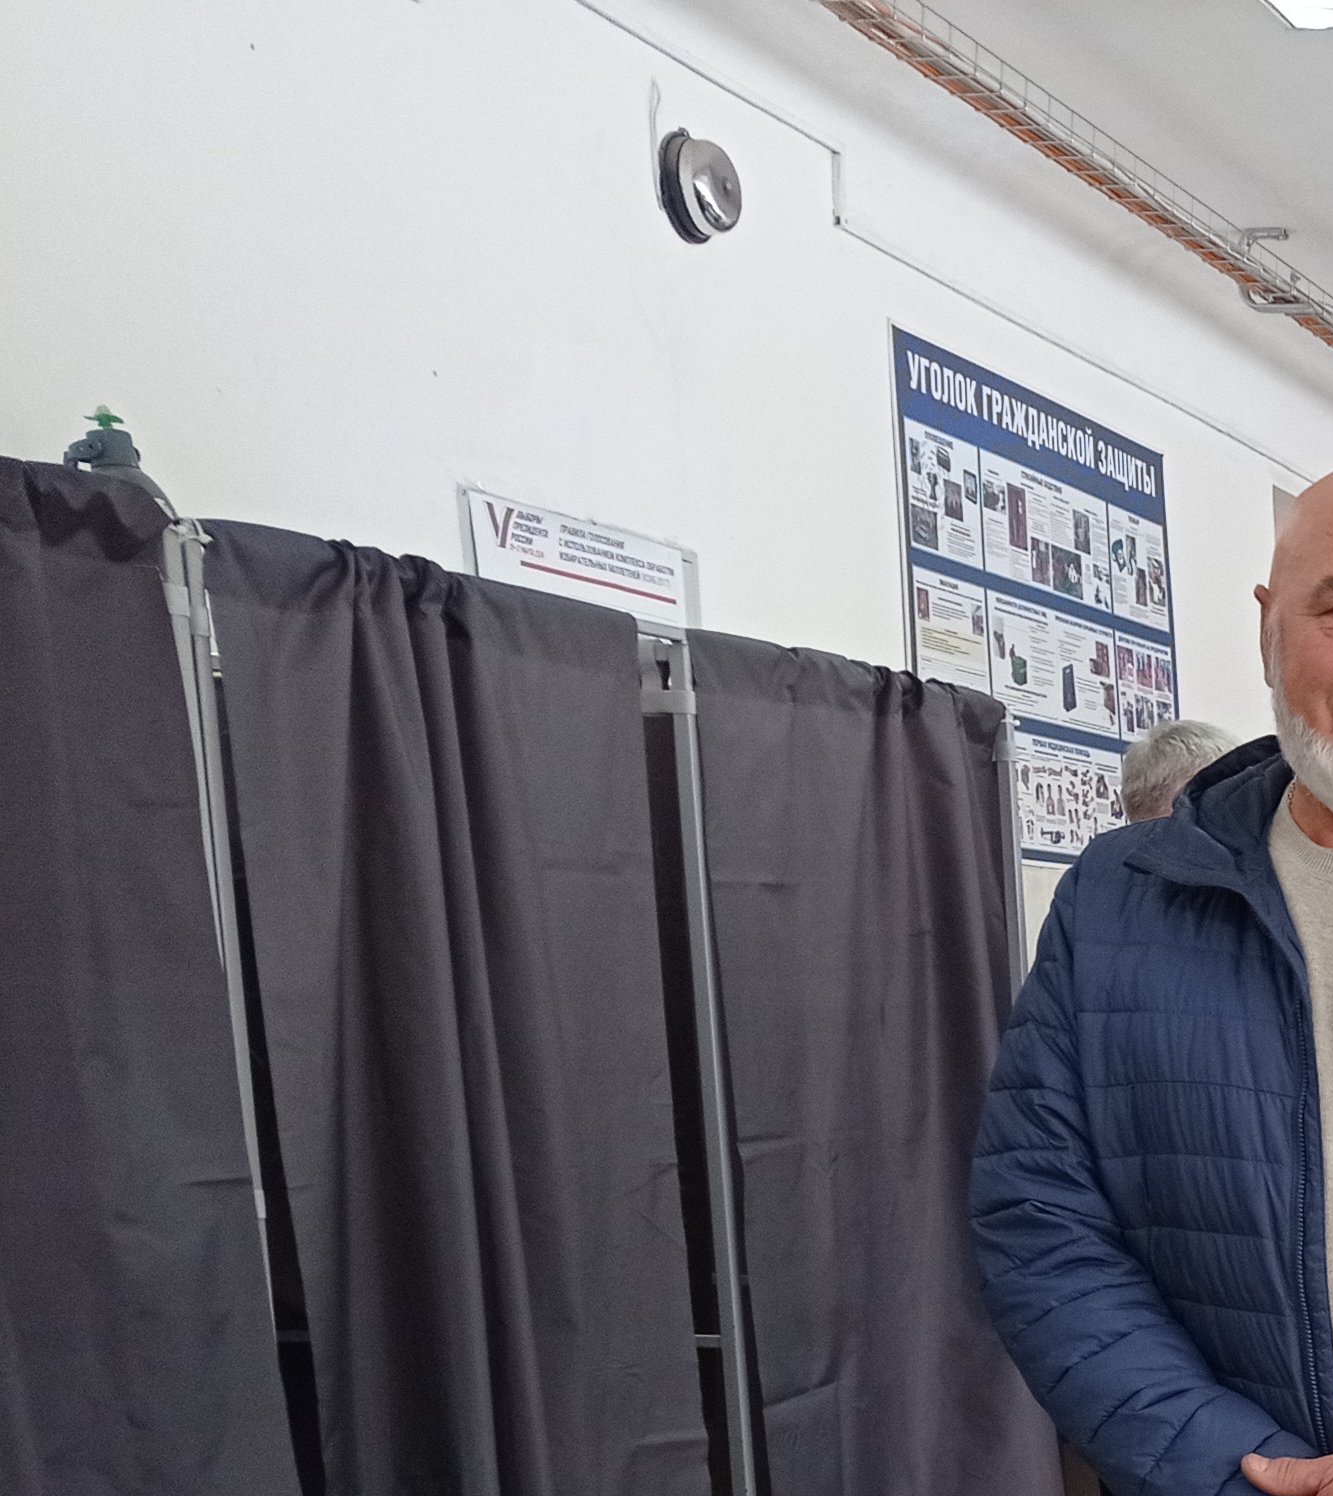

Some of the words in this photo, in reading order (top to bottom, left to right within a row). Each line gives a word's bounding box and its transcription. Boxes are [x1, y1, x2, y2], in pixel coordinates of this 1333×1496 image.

[906, 350, 978, 416] УГОЛОК
[981, 384, 1096, 470] ГРАЖДАНСКОЙ
[1097, 439, 1157, 498] ЗАЩИТЫ
